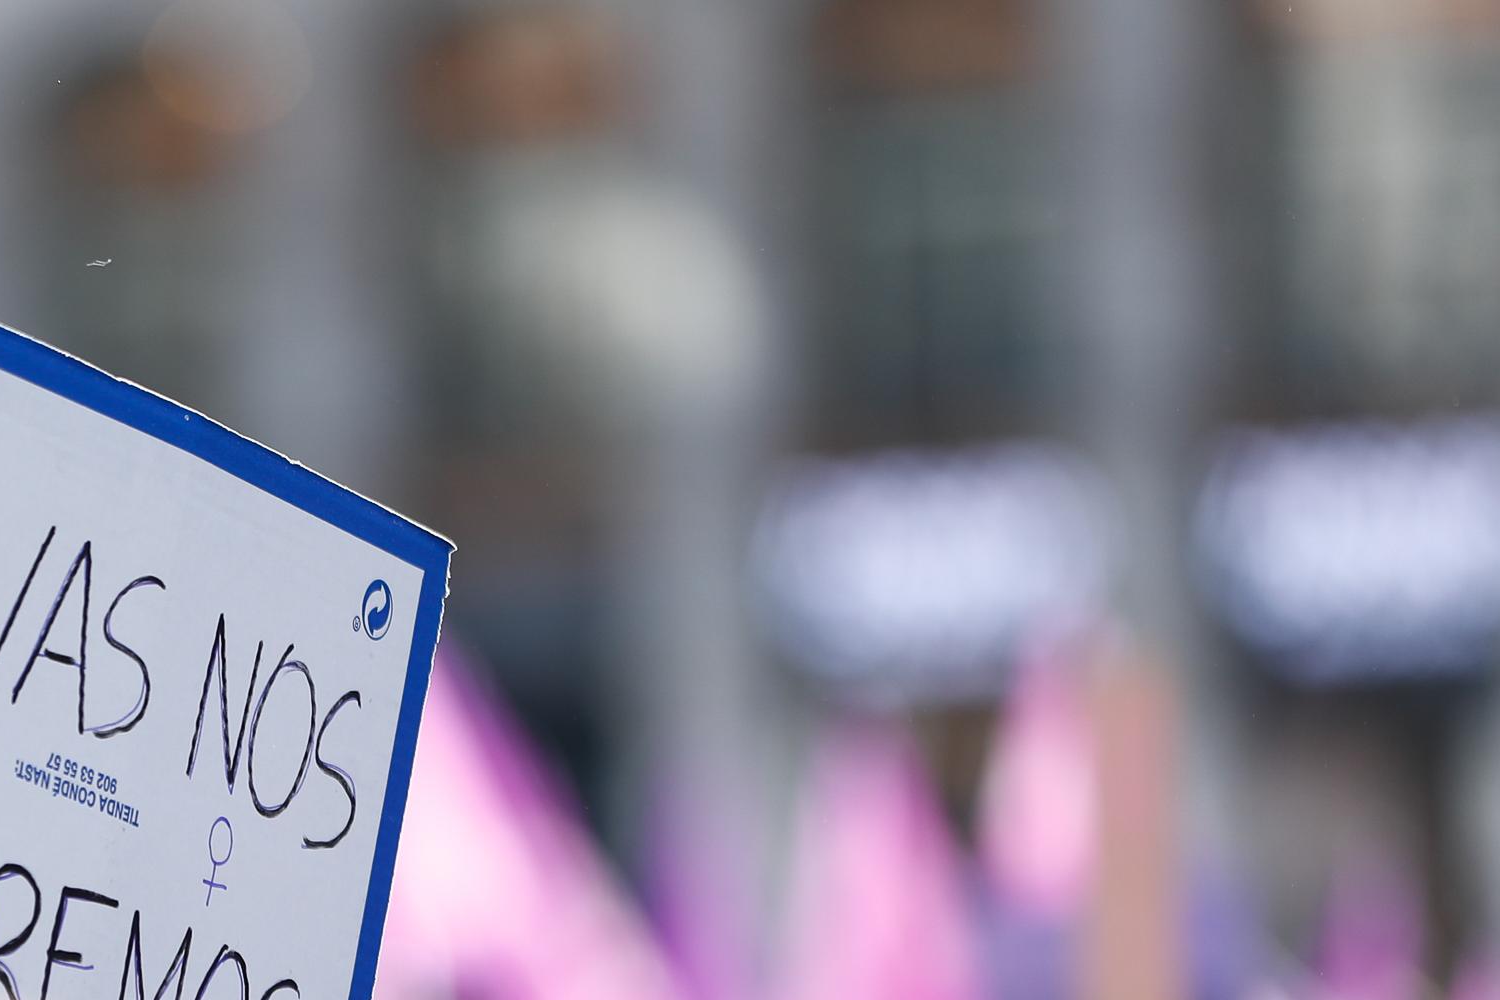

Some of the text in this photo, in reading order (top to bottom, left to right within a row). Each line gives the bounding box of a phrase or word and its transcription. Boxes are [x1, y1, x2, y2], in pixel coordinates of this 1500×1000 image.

[185, 613, 363, 849] NOS
[14, 759, 140, 828] TIENDA CONDÉ NAST:
[46, 752, 118, 795] 902 53 55 57
